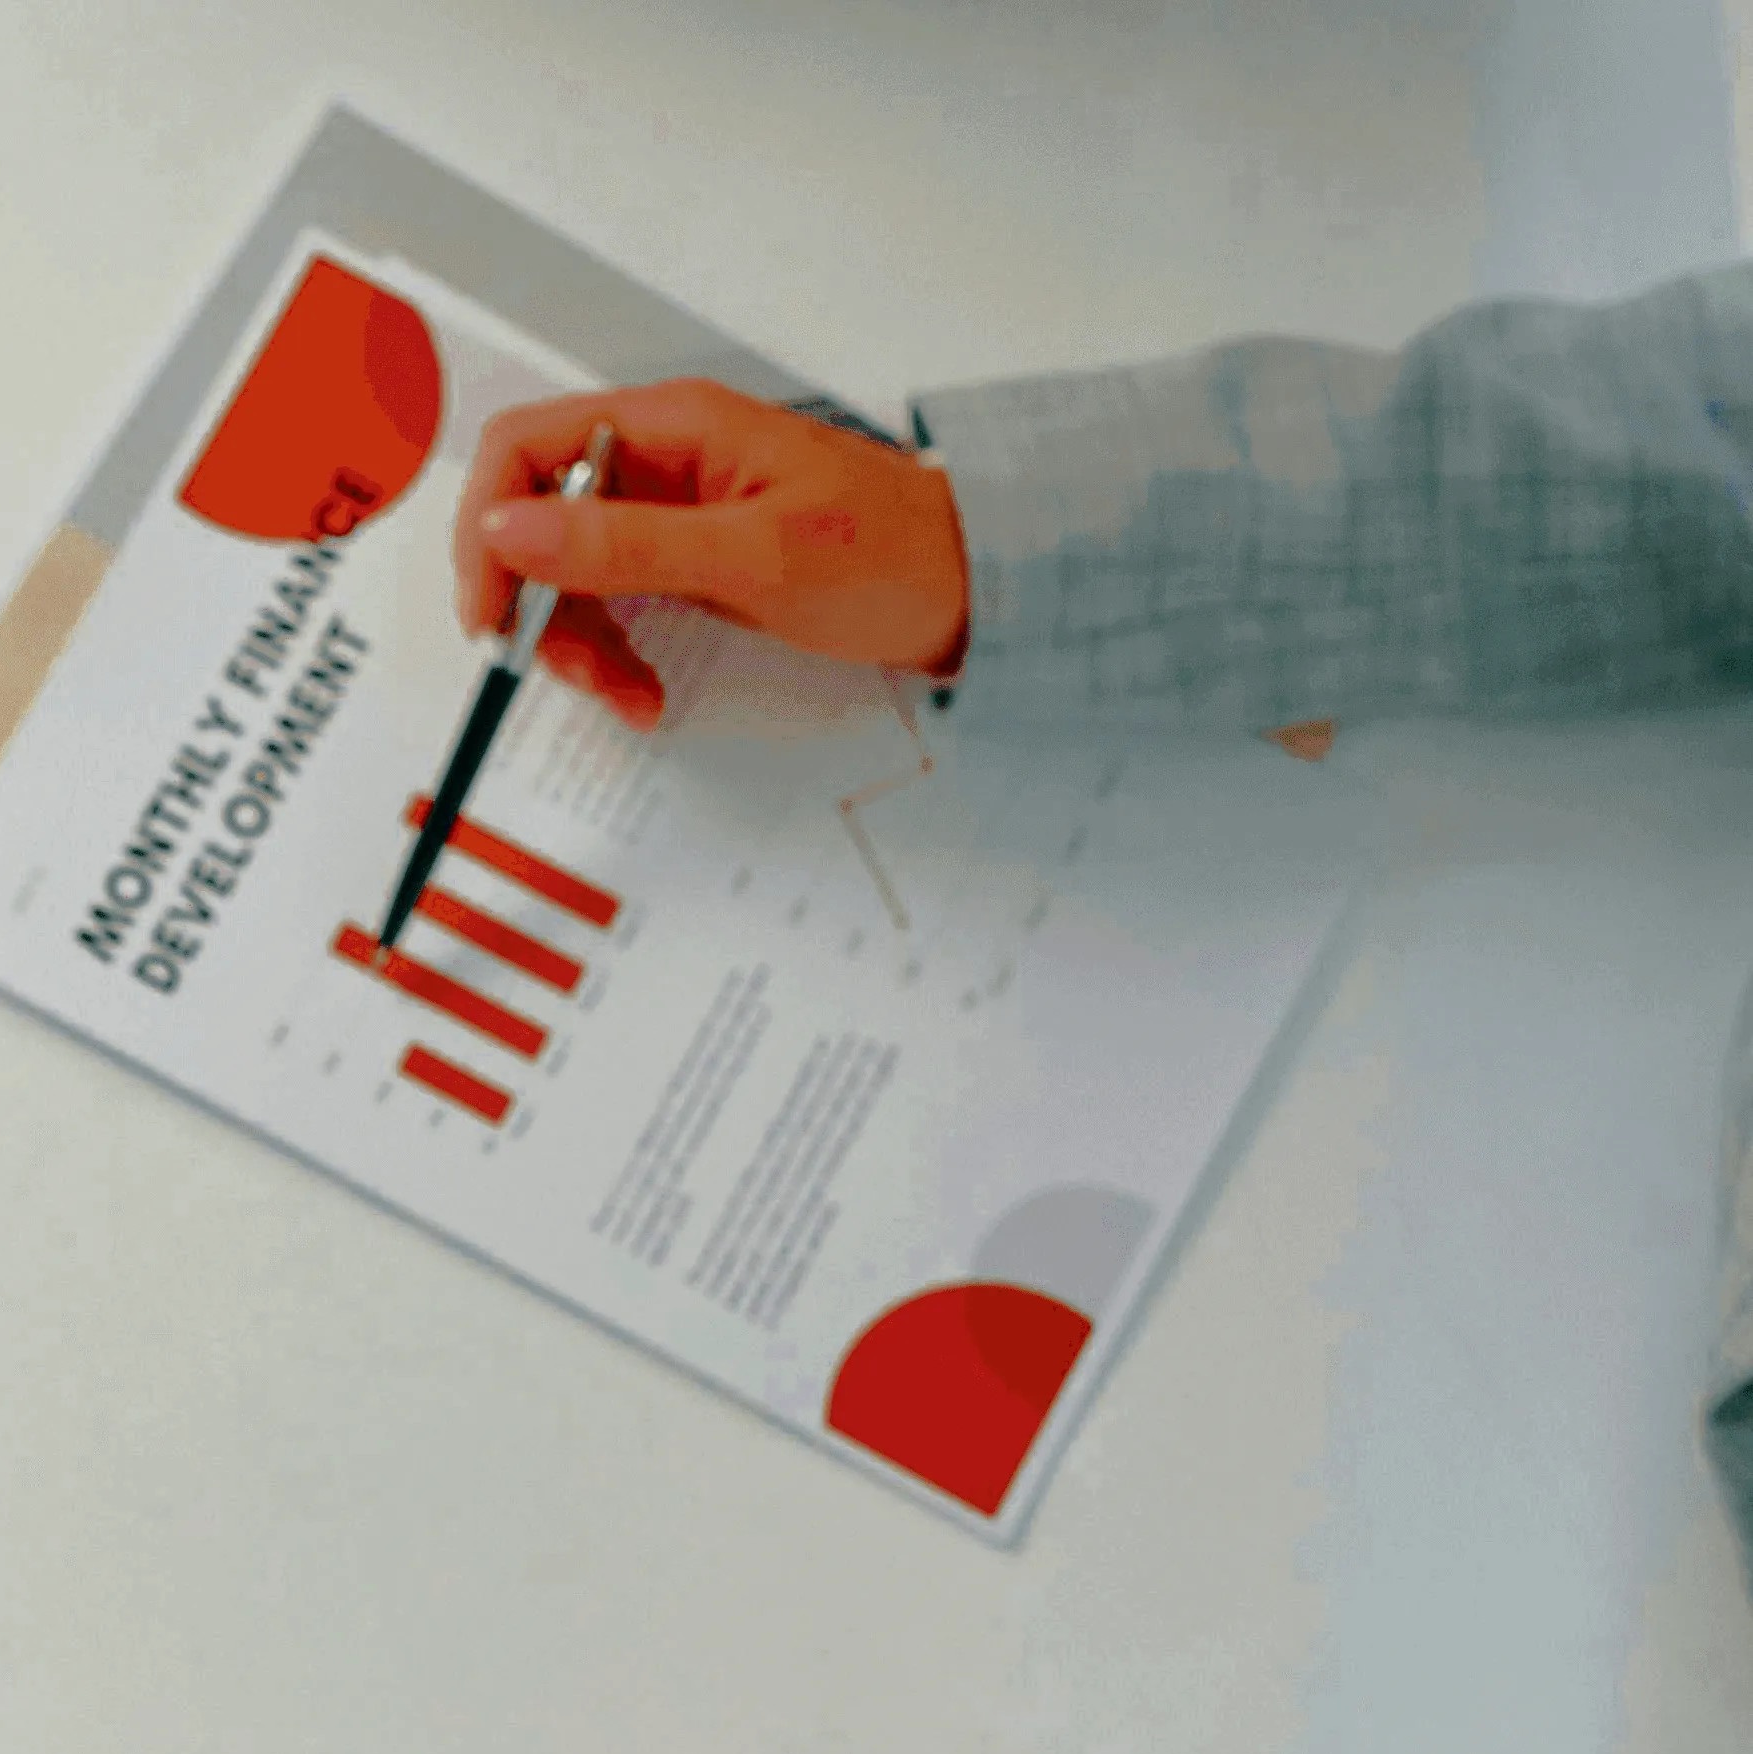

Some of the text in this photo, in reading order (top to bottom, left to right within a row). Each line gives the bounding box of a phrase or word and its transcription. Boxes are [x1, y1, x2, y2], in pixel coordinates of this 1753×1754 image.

[75, 466, 387, 963] MONTHLY FINANCE
[134, 620, 371, 996] DEVELOPMENT
